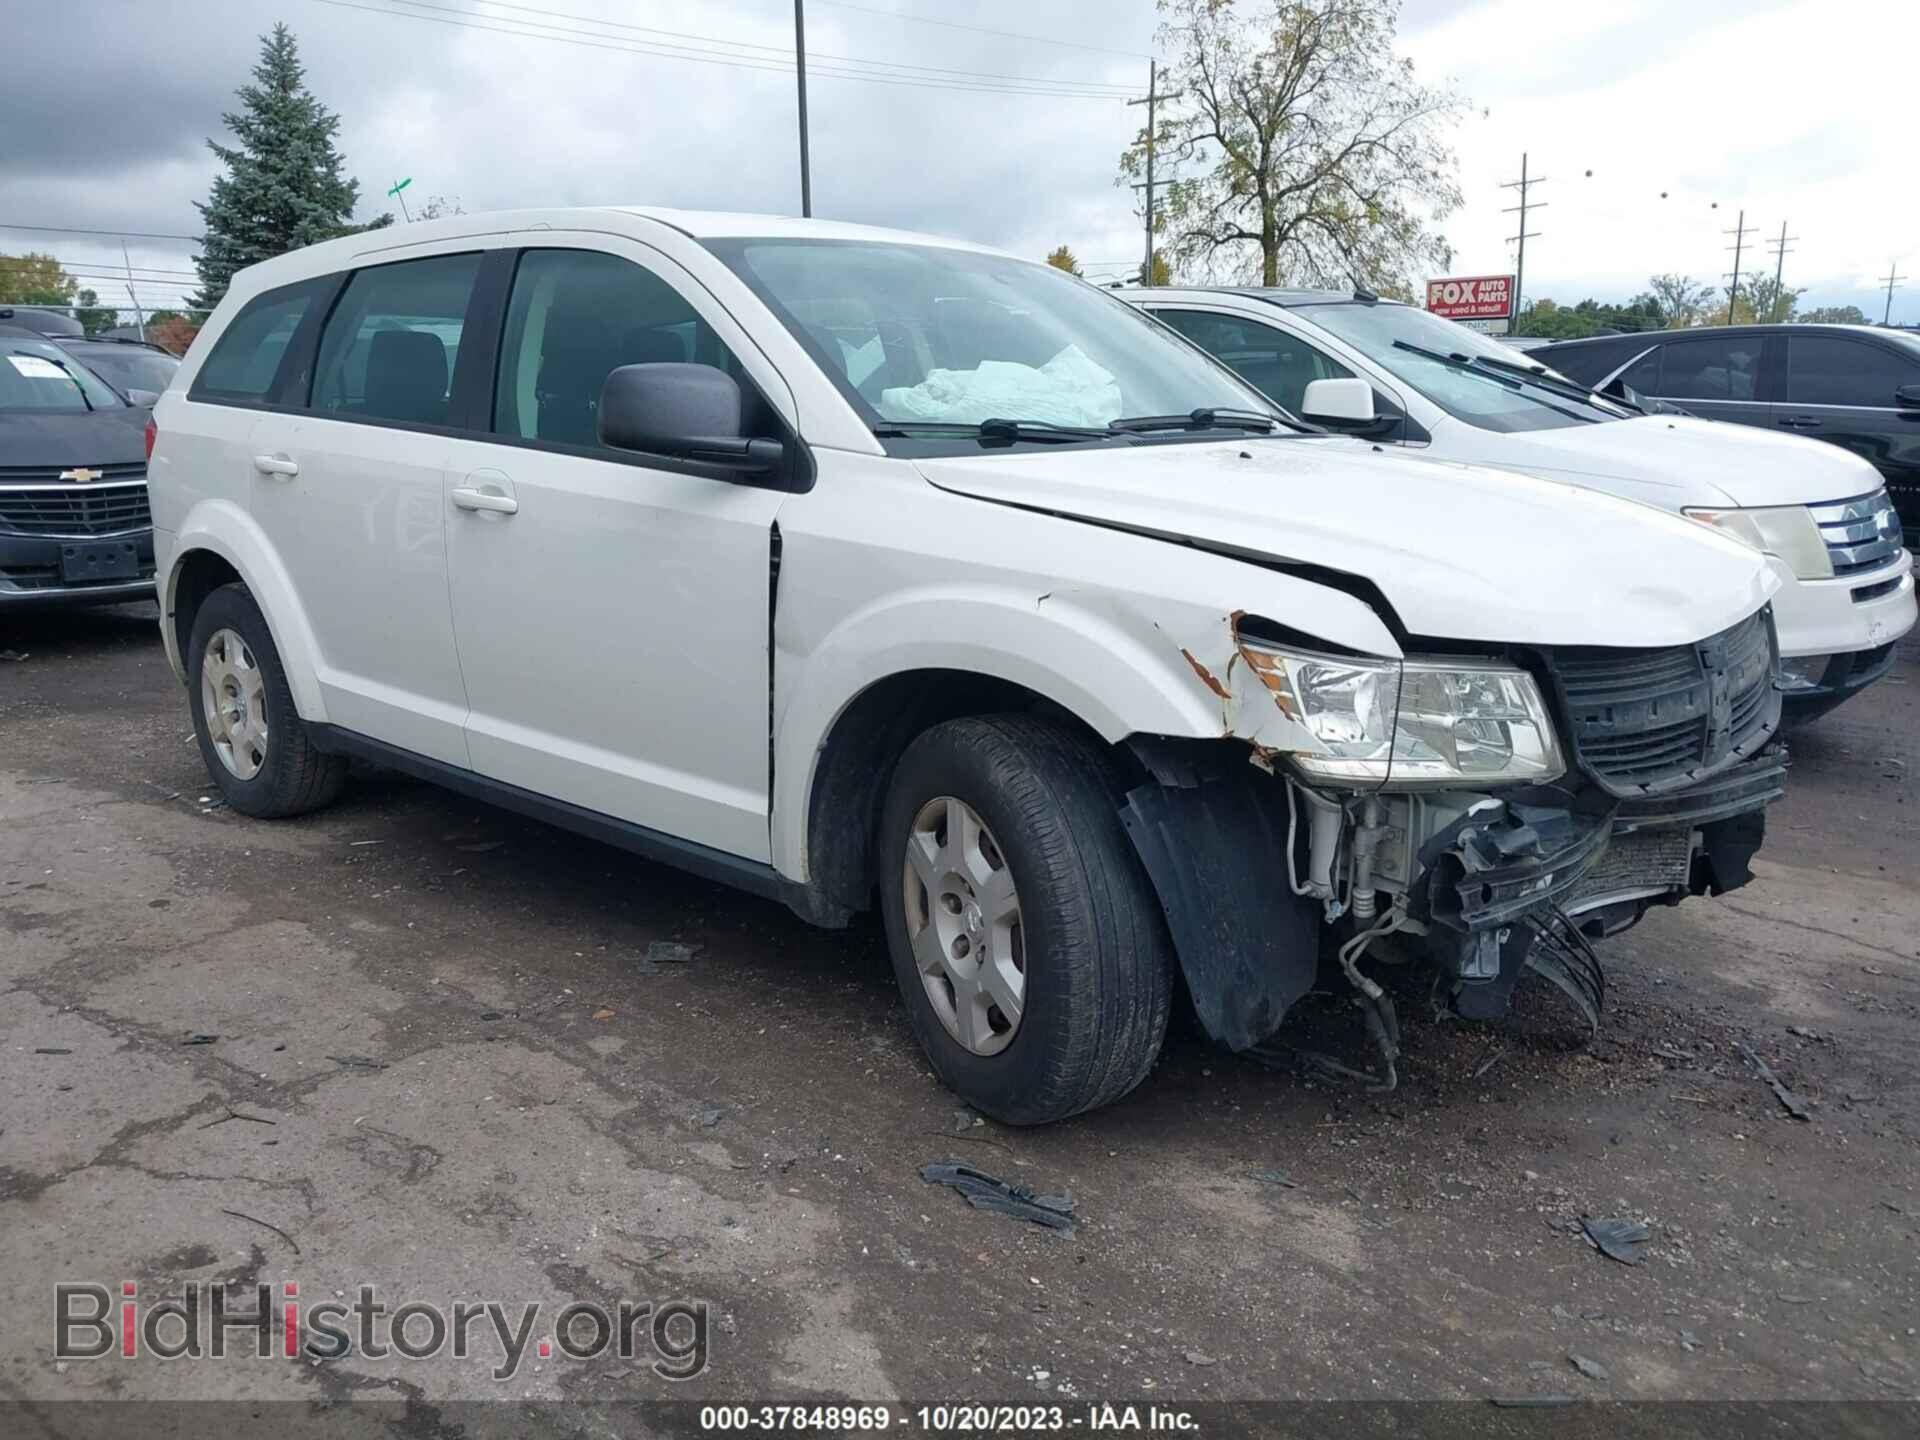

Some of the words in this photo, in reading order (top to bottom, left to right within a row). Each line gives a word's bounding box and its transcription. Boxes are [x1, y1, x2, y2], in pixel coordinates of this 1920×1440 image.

[1479, 279, 1505, 292] AUTO
[1430, 281, 1477, 305] FOX
[1478, 291, 1507, 302] PARTS
[1451, 305, 1470, 314] used
[1470, 305, 1476, 313] &
